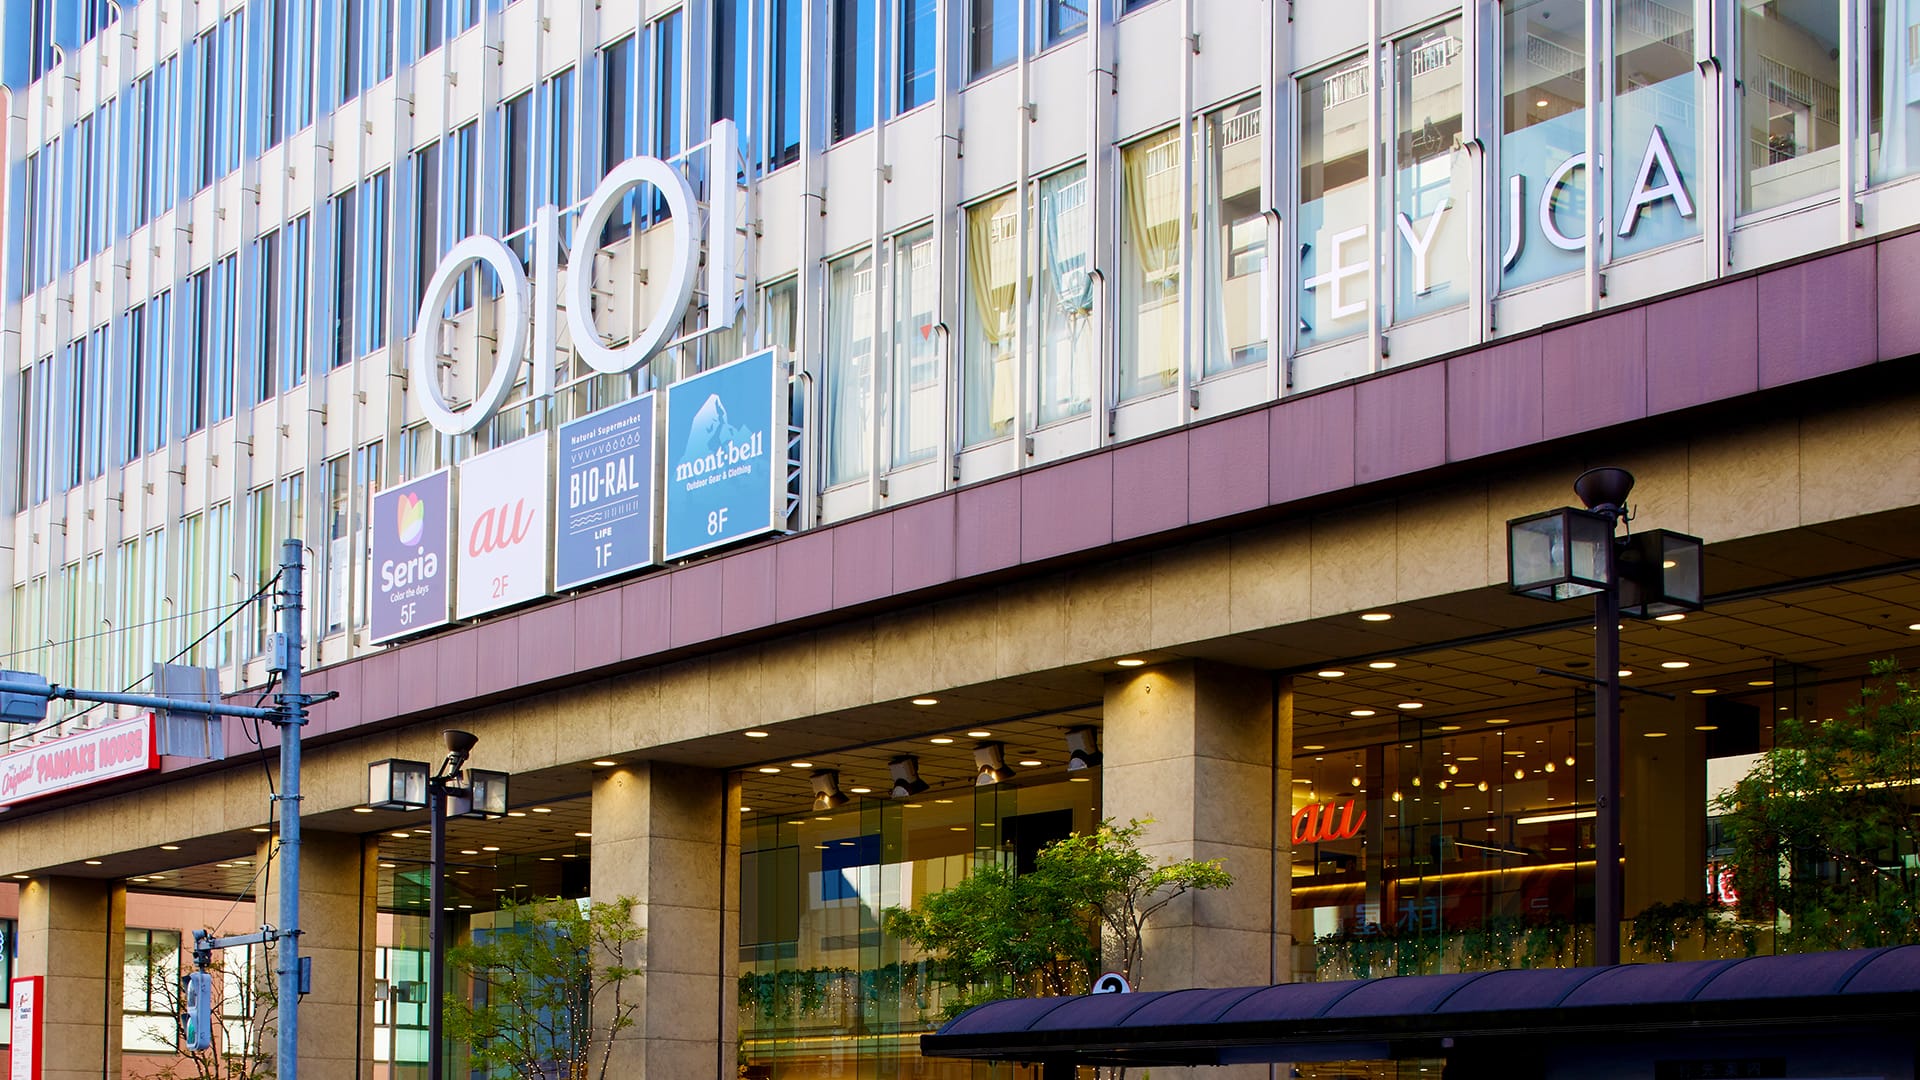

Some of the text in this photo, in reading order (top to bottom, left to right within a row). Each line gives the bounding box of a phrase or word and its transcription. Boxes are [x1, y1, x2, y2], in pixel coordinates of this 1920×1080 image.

[571, 414, 641, 445] Natural Supermarket
[570, 454, 640, 509] BIO-RAL
[686, 465, 752, 491] Outdoor Gear & Clothing
[469, 497, 535, 558] au
[594, 527, 612, 540] LIFE
[707, 507, 728, 536] 8F
[381, 546, 438, 593] Seria
[595, 543, 613, 569] 1F
[390, 584, 430, 604] Color the days
[492, 575, 509, 599] 2F
[400, 602, 416, 626] 5F
[2, 729, 143, 796] Original PANCAKE HOUSE
[1291, 799, 1367, 846] au
